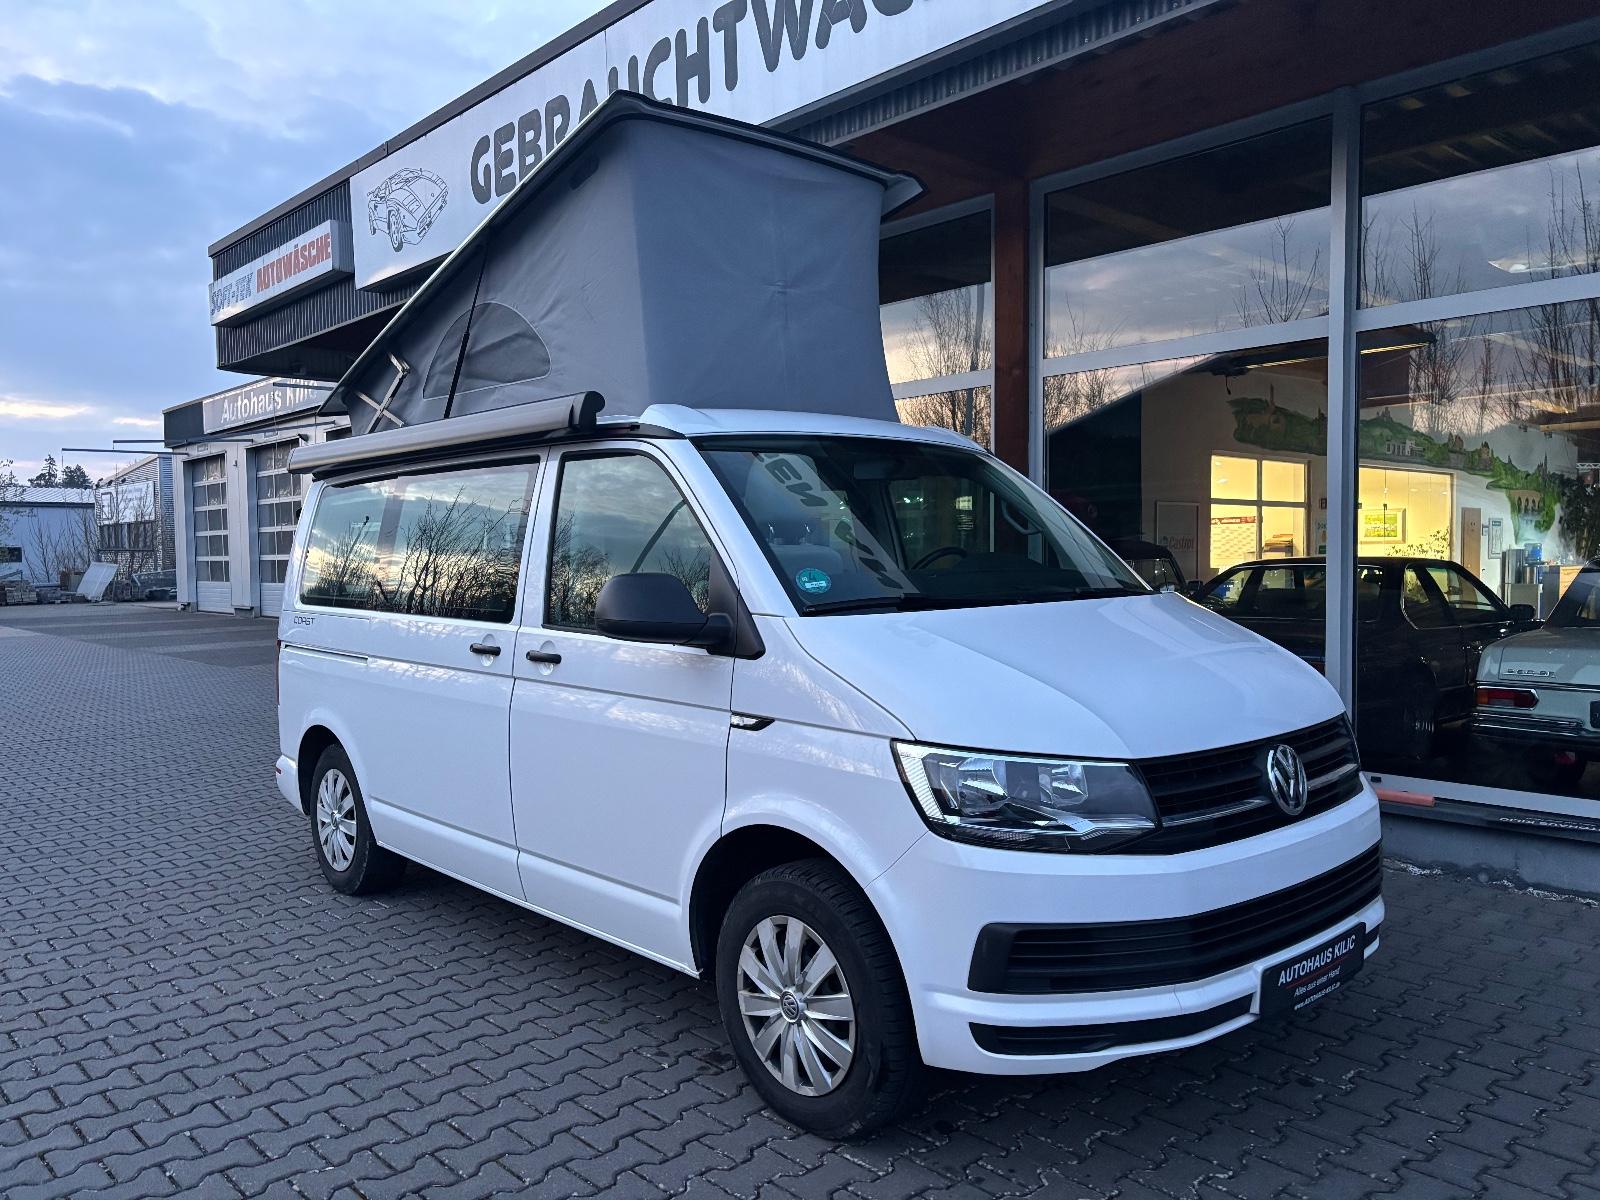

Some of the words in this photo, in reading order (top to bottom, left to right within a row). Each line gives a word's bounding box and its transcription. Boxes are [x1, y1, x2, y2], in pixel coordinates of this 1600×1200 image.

[471, 0, 915, 204] GEBRCHTWA
[256, 233, 331, 293] AUTOWÄSCHE
[220, 388, 282, 423] Autohaus
[1278, 947, 1332, 987] AUTOHAUS
[1334, 935, 1356, 959] KILIC
